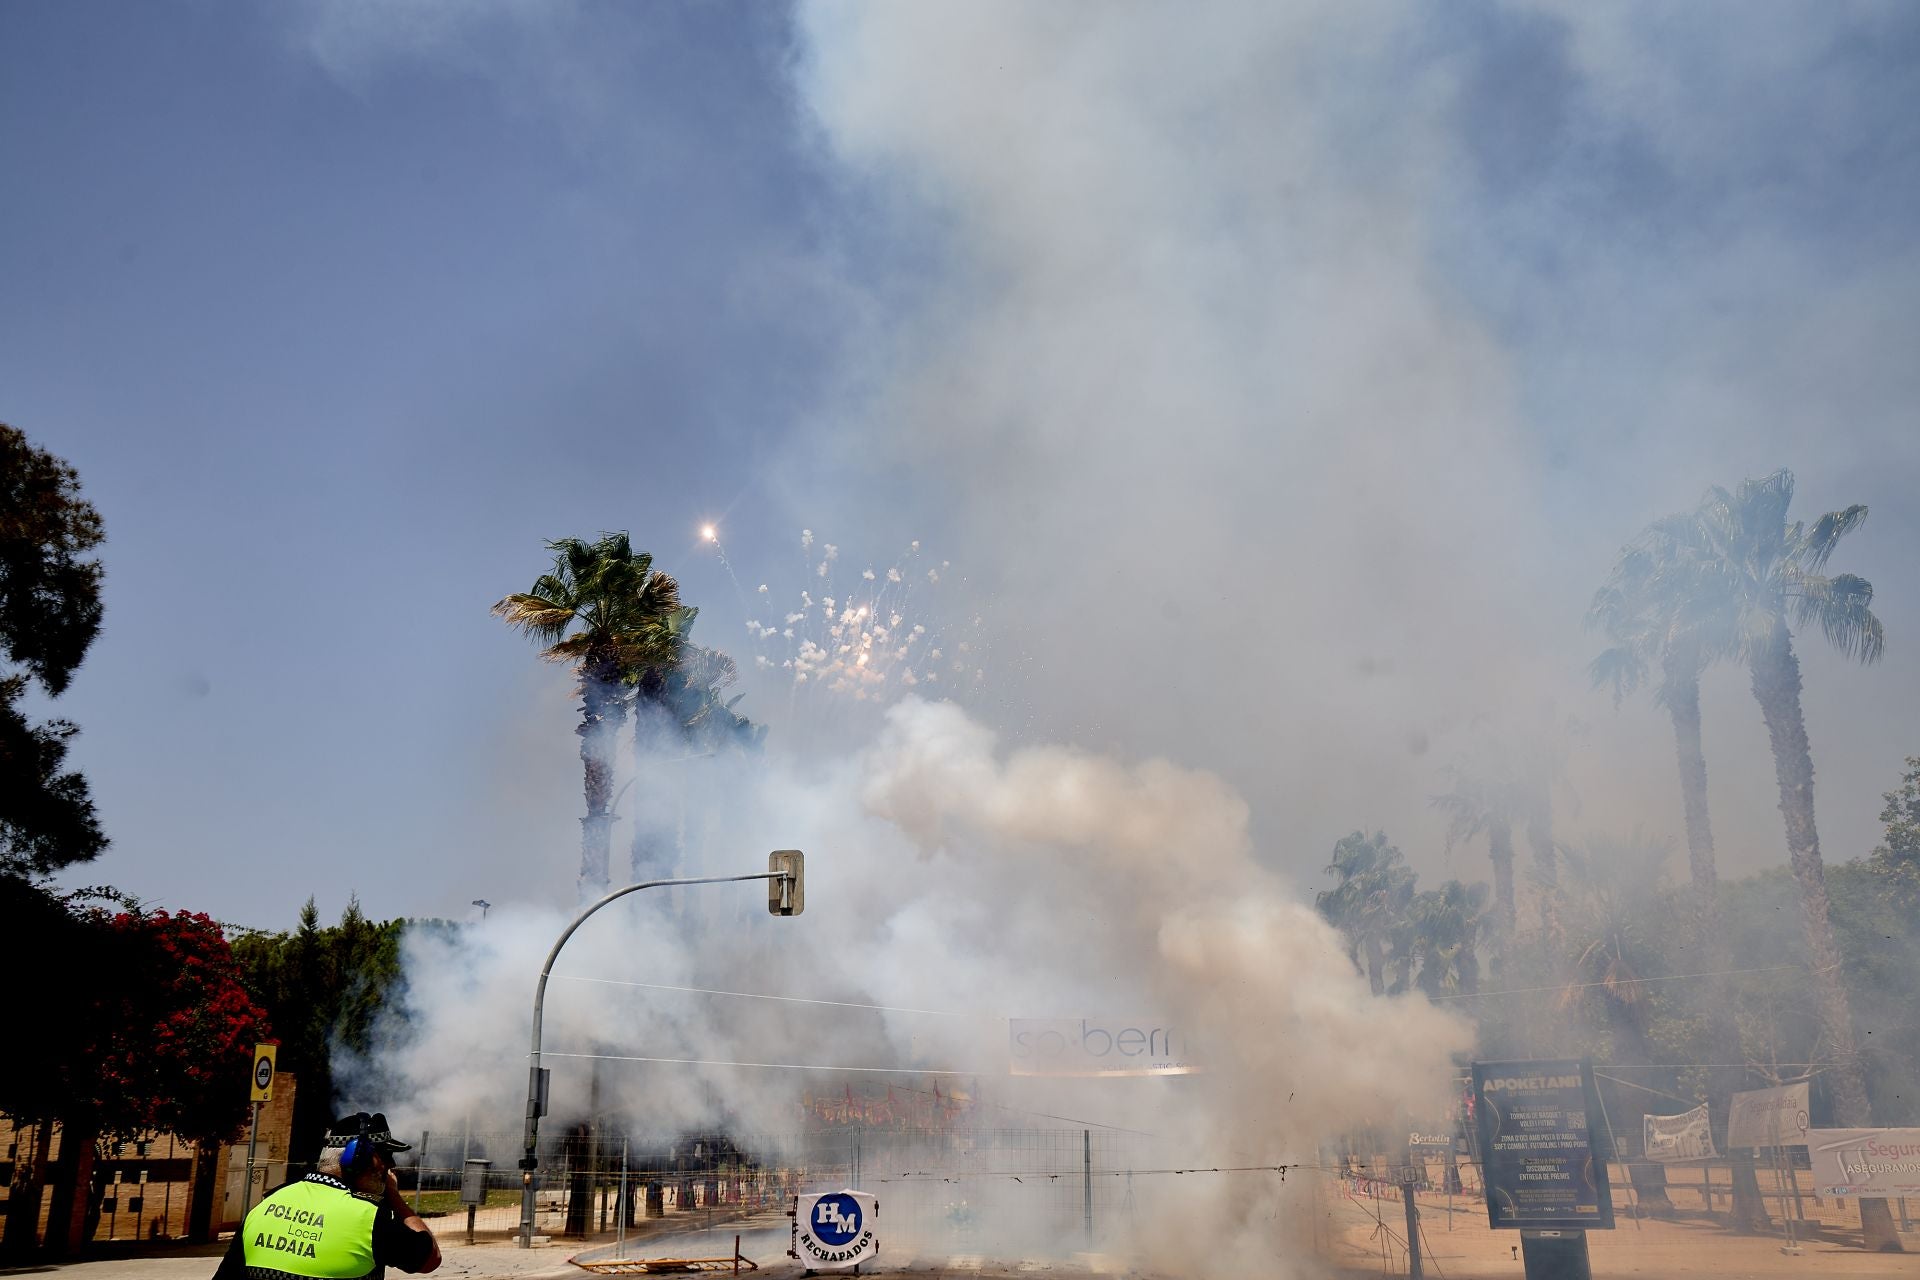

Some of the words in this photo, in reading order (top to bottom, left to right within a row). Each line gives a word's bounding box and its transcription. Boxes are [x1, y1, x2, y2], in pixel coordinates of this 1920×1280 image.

[263, 1203, 325, 1228] POLICIA
[817, 1202, 856, 1234] HM
[254, 1232, 317, 1259] ALDAIA
[287, 1224, 323, 1242] Local
[800, 1230, 873, 1261] RECHAPADOS
